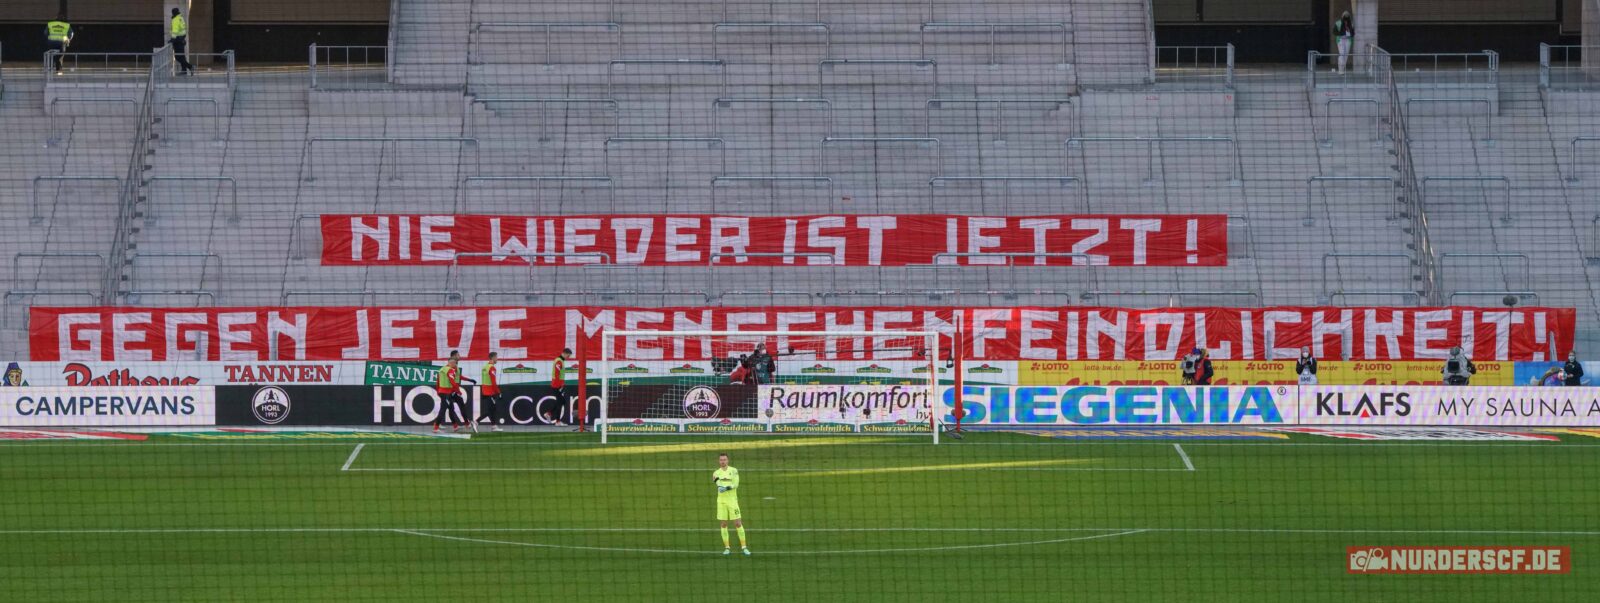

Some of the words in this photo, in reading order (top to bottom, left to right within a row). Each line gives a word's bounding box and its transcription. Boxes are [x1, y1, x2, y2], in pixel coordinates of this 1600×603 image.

[350, 215, 456, 262] NIE
[489, 216, 750, 264] WIEDER
[782, 216, 898, 266] IST
[57, 310, 308, 362] GEGEN
[341, 308, 528, 360] JEDE
[223, 364, 334, 383] TANNEN
[370, 363, 440, 384] TANNE
[1041, 362, 1070, 371] LOTTO
[1149, 362, 1177, 371] LOTTO
[1256, 362, 1285, 371] LOTTO
[1364, 363, 1393, 371] LOTTO
[1475, 363, 1501, 371] OTTO
[15, 396, 196, 416] CAMPERVANS
[769, 385, 928, 413] Raumkomfort
[1316, 392, 1412, 417] KLAFS
[1437, 398, 1475, 416] MY
[1486, 397, 1577, 417] SAUNA
[687, 424, 764, 432] Schwarzwaldmilch
[775, 424, 852, 432] Schwarzwaldmilch
